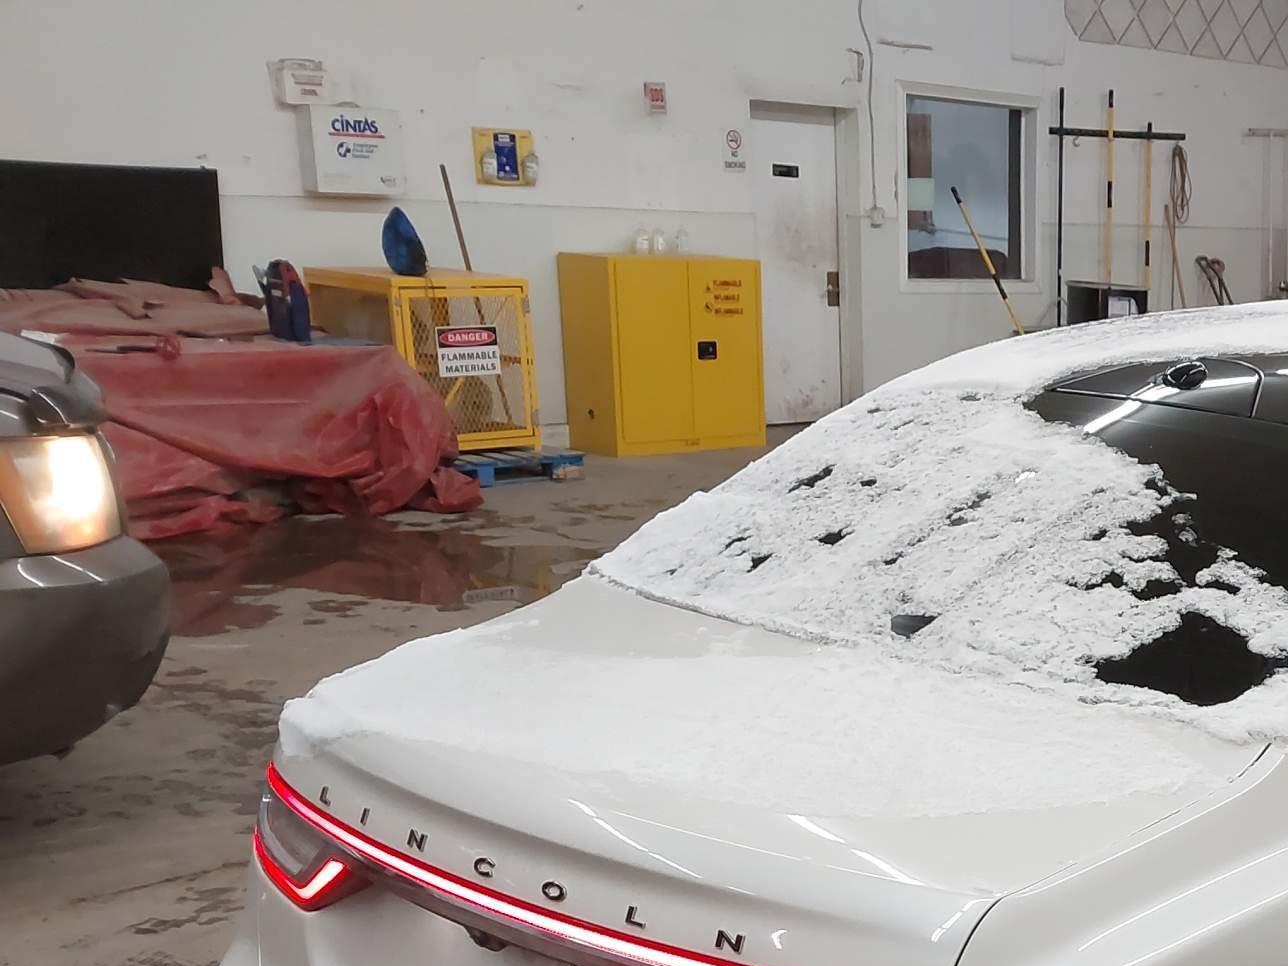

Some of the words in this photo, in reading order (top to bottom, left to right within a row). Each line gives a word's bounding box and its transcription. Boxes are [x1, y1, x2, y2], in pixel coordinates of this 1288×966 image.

[330, 114, 379, 134] CINTAS
[447, 332, 489, 342] DANGER
[441, 351, 498, 361] FLAMMABLE
[445, 363, 497, 373] MATERIALS
[319, 786, 746, 954] LINCOLN
